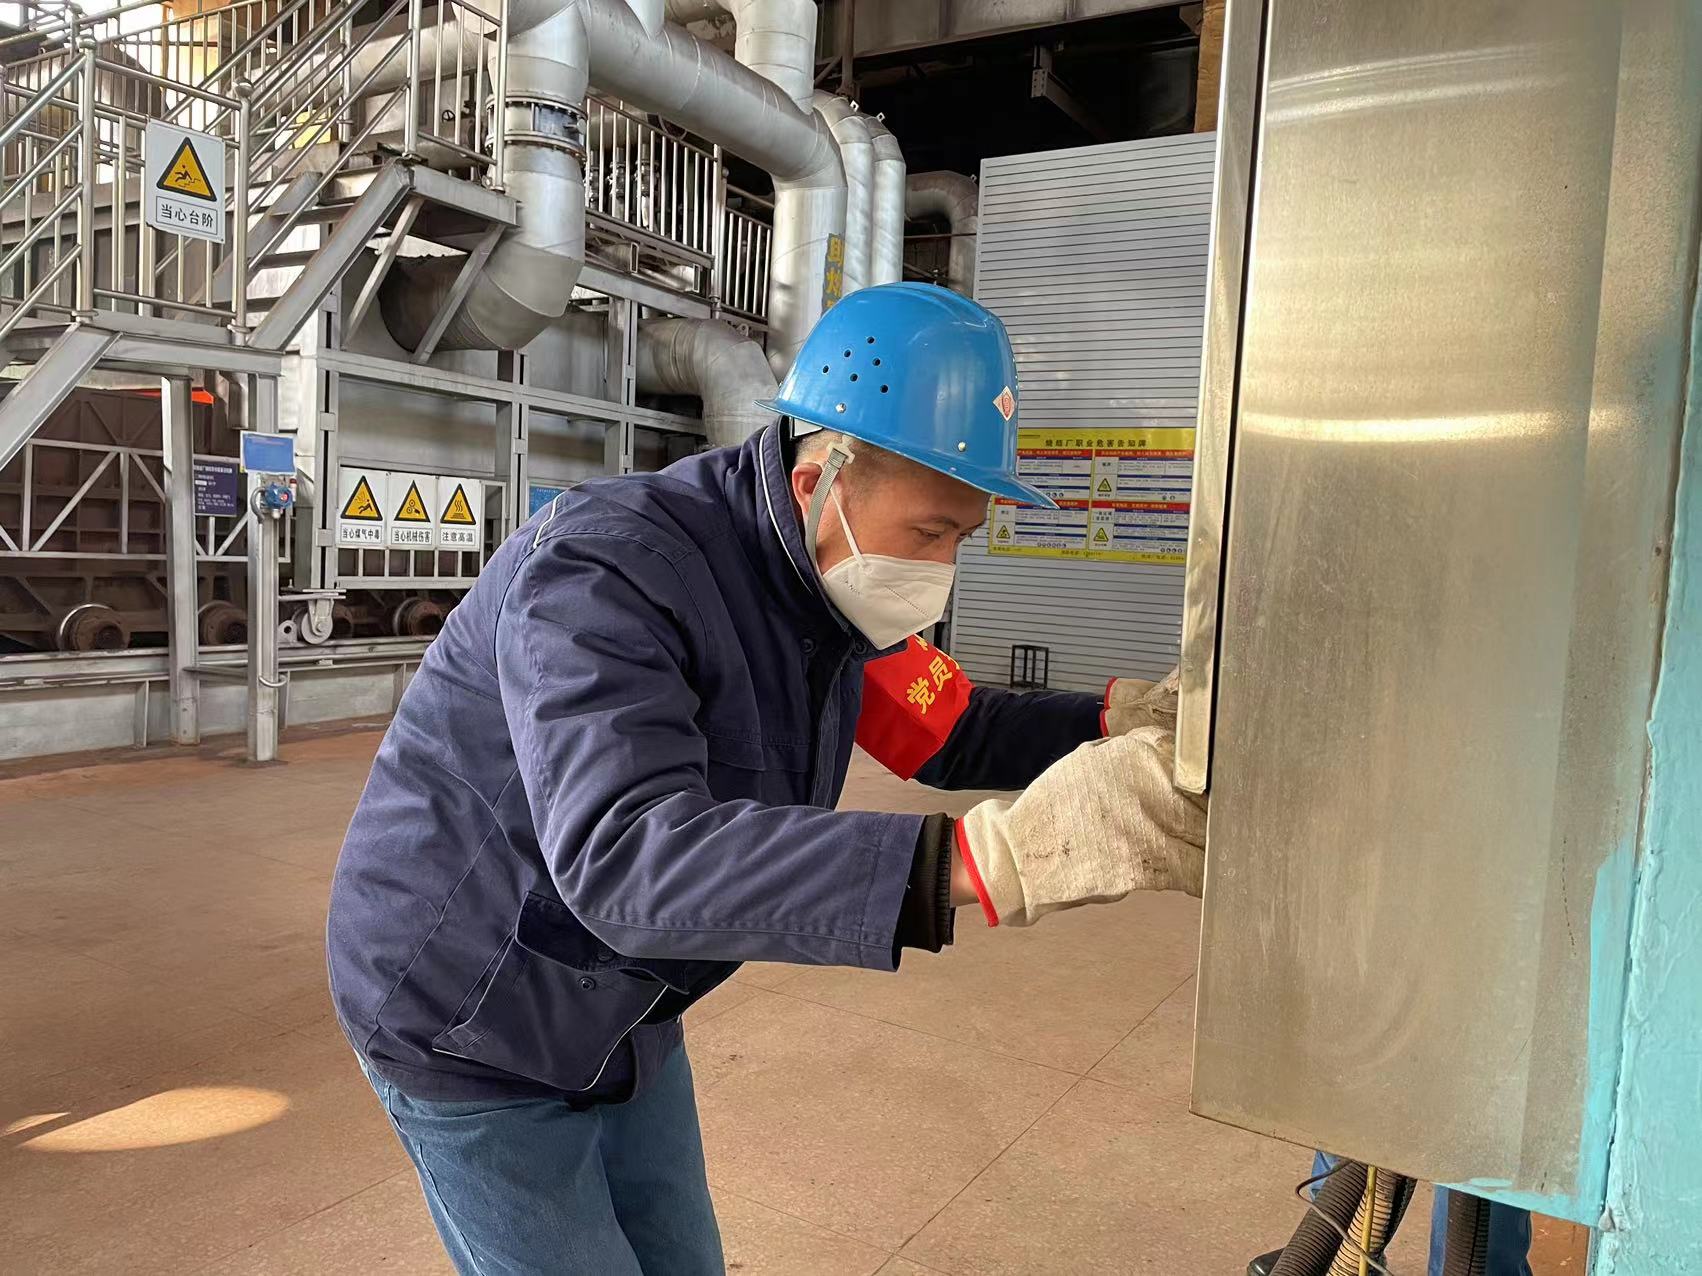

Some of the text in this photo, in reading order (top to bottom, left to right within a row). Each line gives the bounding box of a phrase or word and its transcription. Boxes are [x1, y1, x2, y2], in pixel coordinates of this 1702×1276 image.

[161, 203, 213, 228] 当心台阶
[342, 527, 380, 540] 当心煤气中毒
[394, 530, 431, 543] 当心机械伤害
[442, 531, 473, 542] 注意高温
[906, 650, 960, 715] 党员
